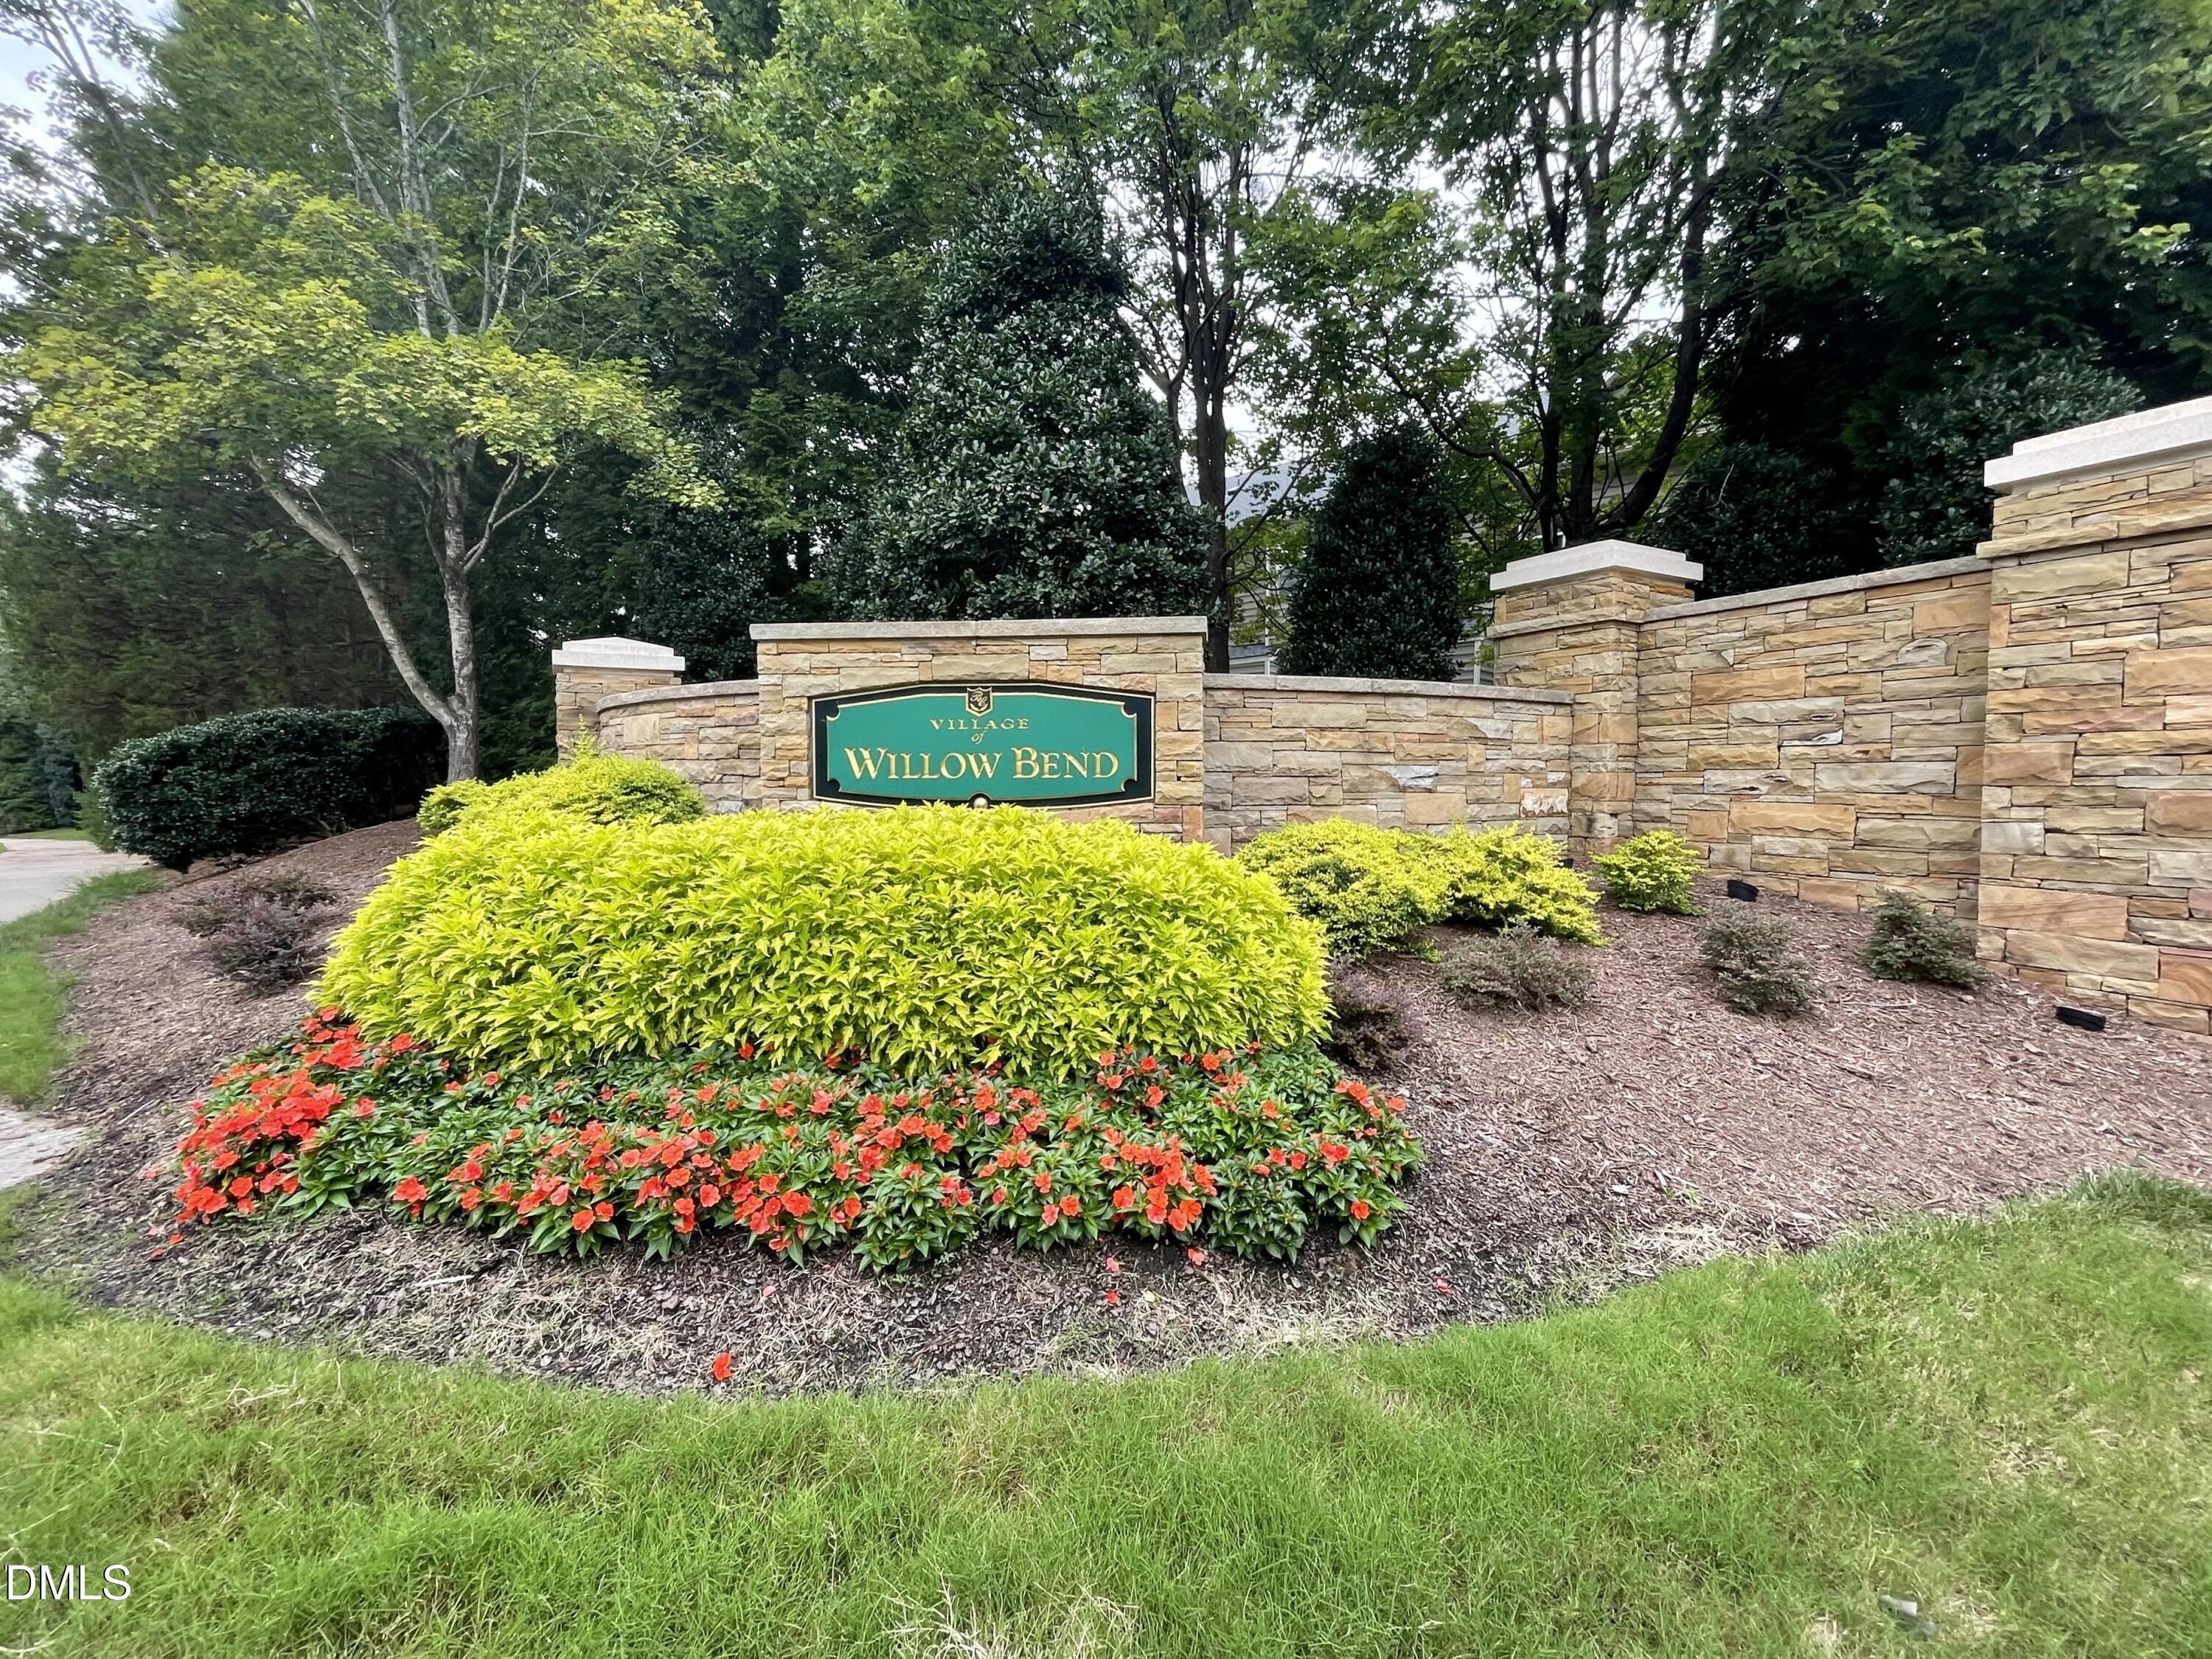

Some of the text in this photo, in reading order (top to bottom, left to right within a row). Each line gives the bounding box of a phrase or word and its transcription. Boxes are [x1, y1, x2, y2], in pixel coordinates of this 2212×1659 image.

[929, 718, 1029, 731] VILLAGE
[971, 730, 987, 745] of
[844, 746, 1119, 779] WILLOW BEND
